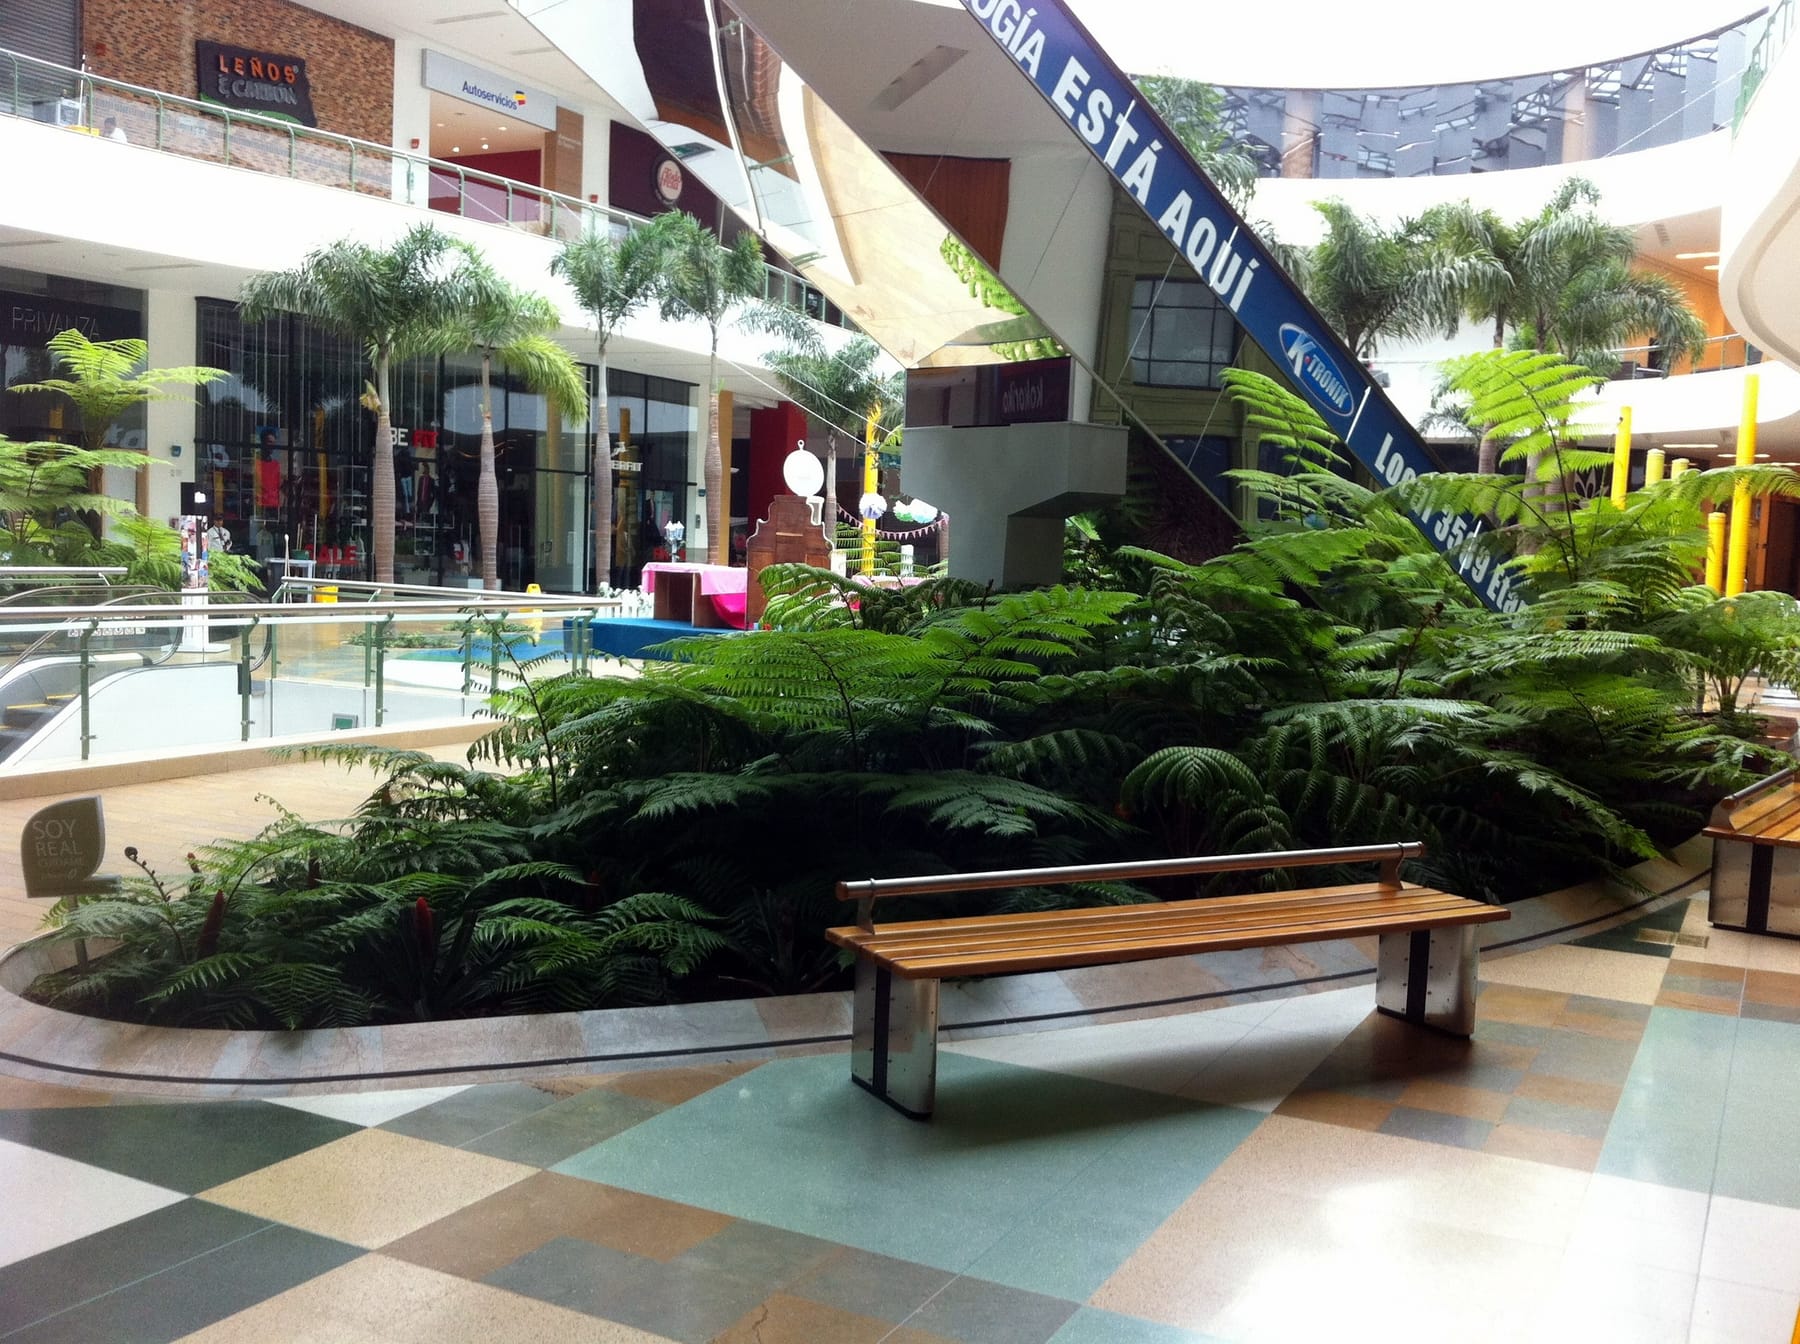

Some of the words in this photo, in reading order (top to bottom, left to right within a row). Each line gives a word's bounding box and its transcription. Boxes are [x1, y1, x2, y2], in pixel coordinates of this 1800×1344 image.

[218, 54, 297, 84] LEÑOS
[462, 80, 518, 111] Autoservicios
[967, 0, 1047, 79] GÍA
[1051, 55, 1163, 206] ESTÁ
[1158, 189, 1261, 313] AQUÍ
[388, 426, 409, 447] BE
[610, 459, 643, 472] ERFIT
[32, 818, 76, 840] SOY
[35, 839, 83, 857] REAL
